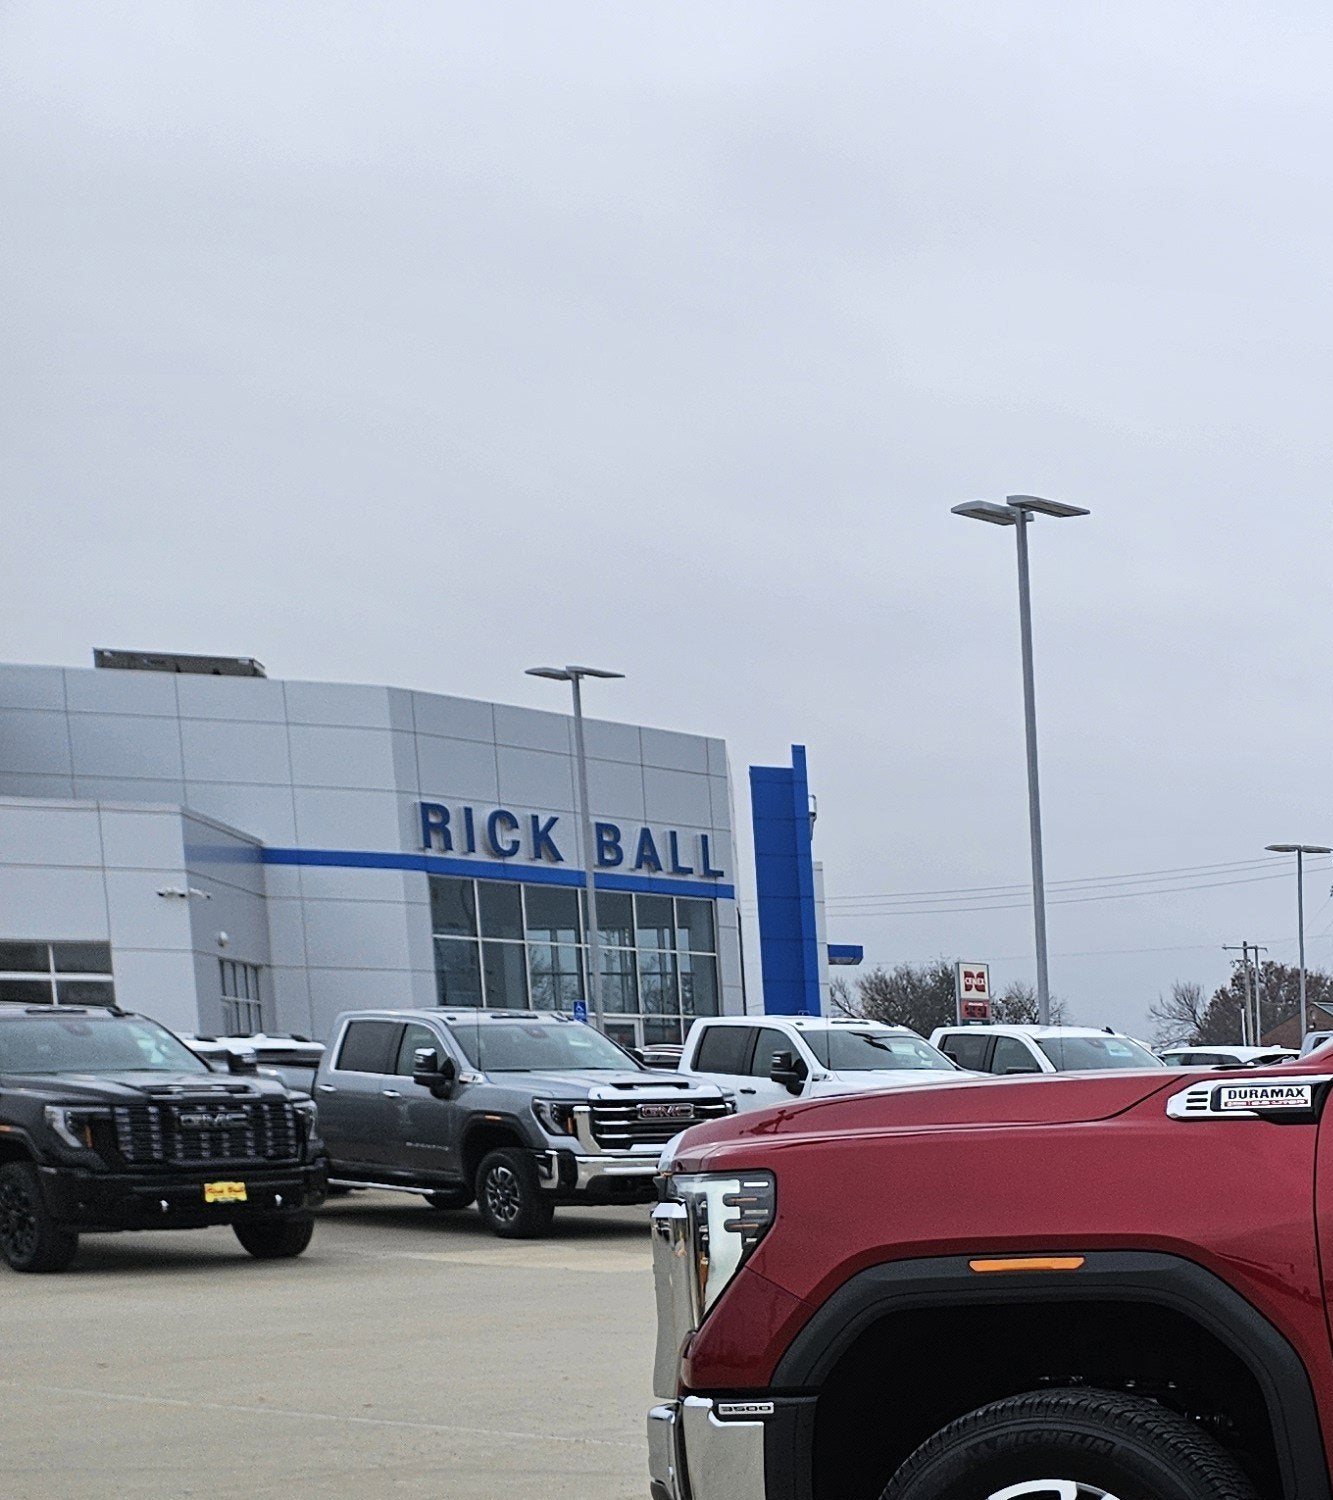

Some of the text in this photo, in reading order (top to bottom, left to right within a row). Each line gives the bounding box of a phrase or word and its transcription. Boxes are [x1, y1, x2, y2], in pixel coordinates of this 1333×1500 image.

[419, 801, 725, 878] RICK BALL
[1228, 1087, 1305, 1100] DURAMAX
[641, 1105, 692, 1118] GMC
